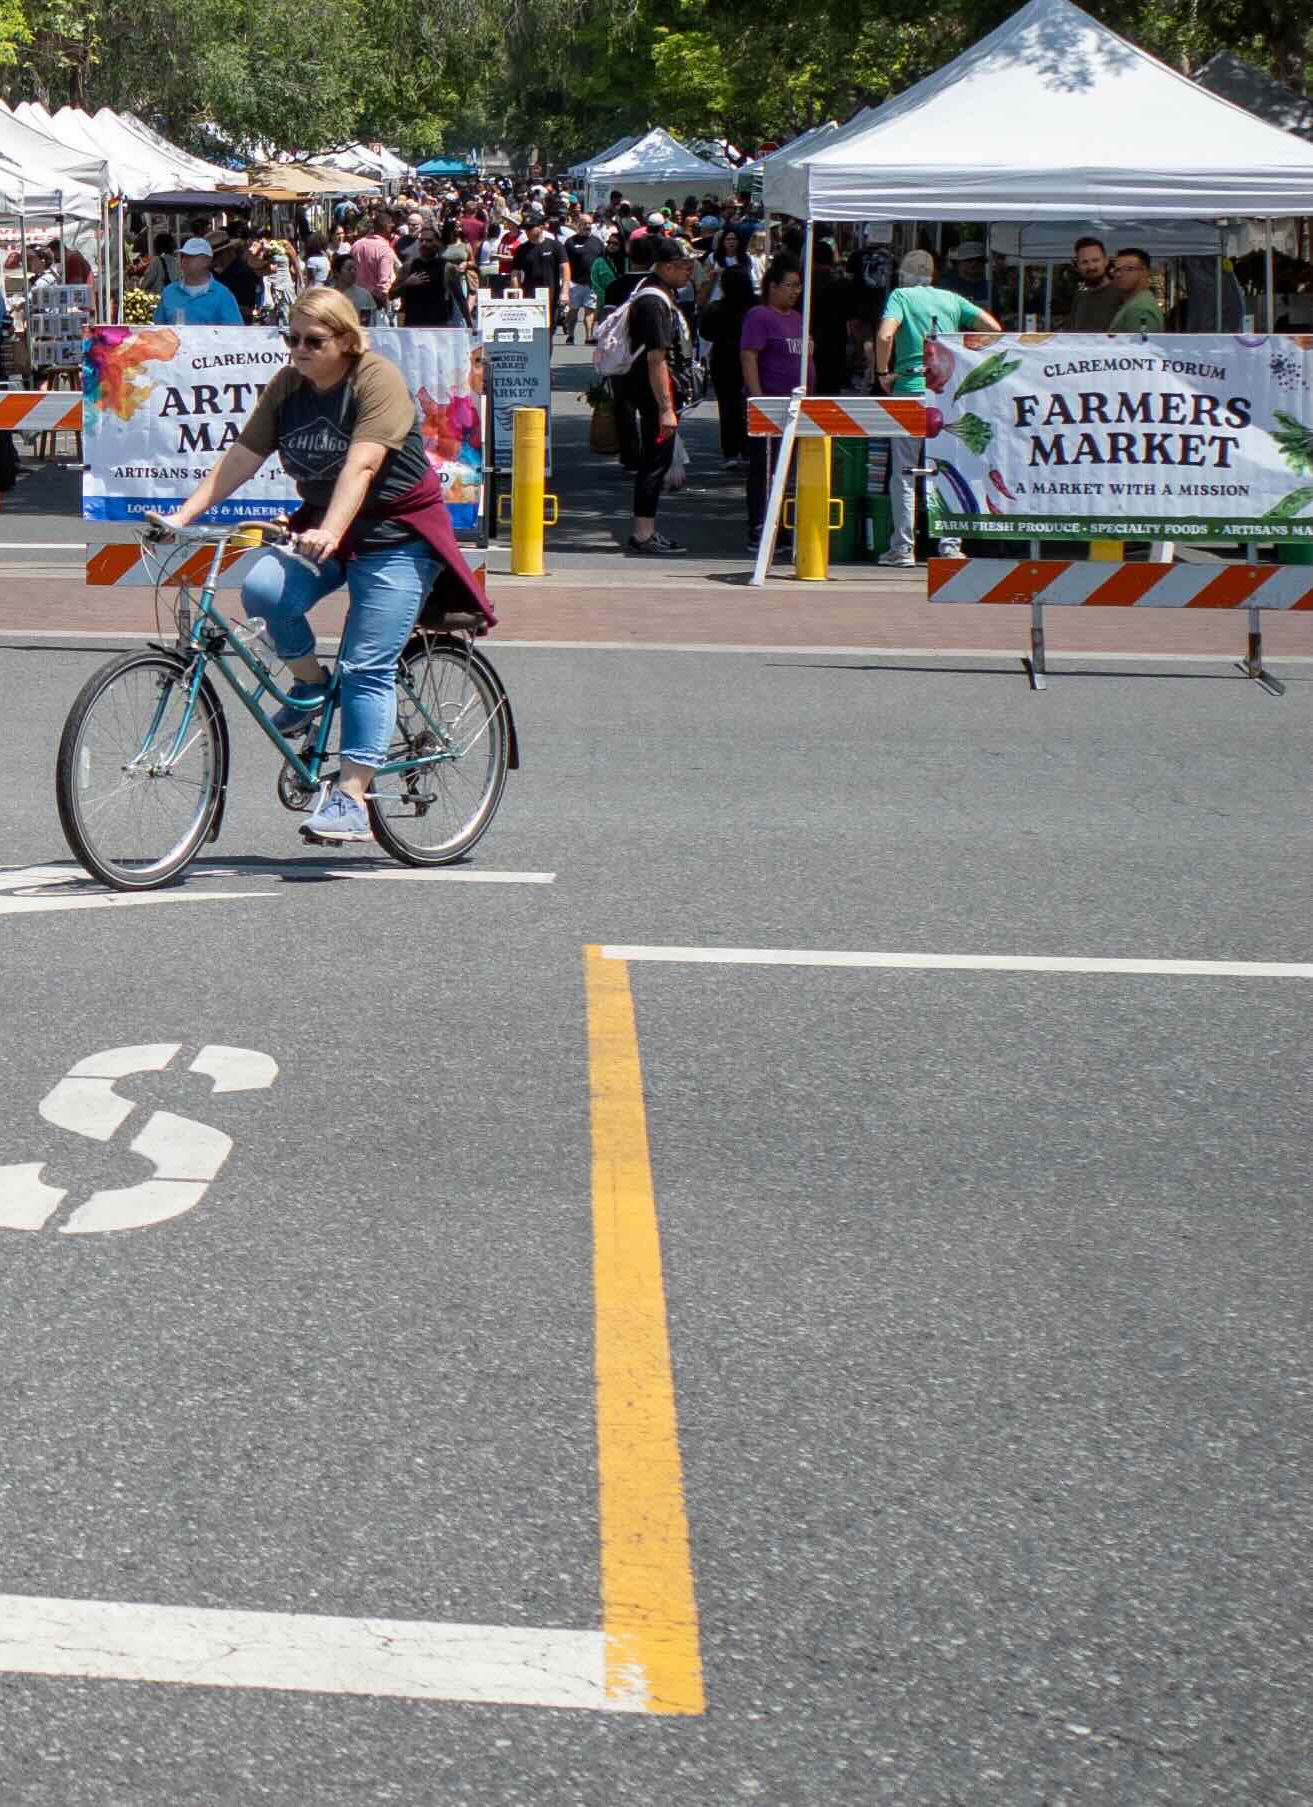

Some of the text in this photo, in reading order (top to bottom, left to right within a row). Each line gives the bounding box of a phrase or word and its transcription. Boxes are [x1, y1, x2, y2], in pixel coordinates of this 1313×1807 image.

[192, 352, 292, 369] CLAREMONT
[1044, 358, 1226, 380] CLAREMONT FORUM
[494, 377, 539, 387] TISANS
[493, 388, 535, 398] ARKET
[1012, 392, 1252, 429] FARMERS
[1028, 432, 1240, 468] MARKET
[114, 467, 188, 479] ARTISANS
[1015, 483, 1250, 496] A MARKET WITH A MISSION
[127, 503, 166, 514] LOCAL
[233, 506, 285, 516] MAKERS
[935, 520, 969, 530] FARM
[973, 522, 1014, 531] FRESH
[1018, 522, 1079, 533] PRODUCE
[1090, 523, 1161, 534] SPECIALTY
[1164, 524, 1208, 535] FOODS
[1222, 524, 1288, 535] ARTISANS
